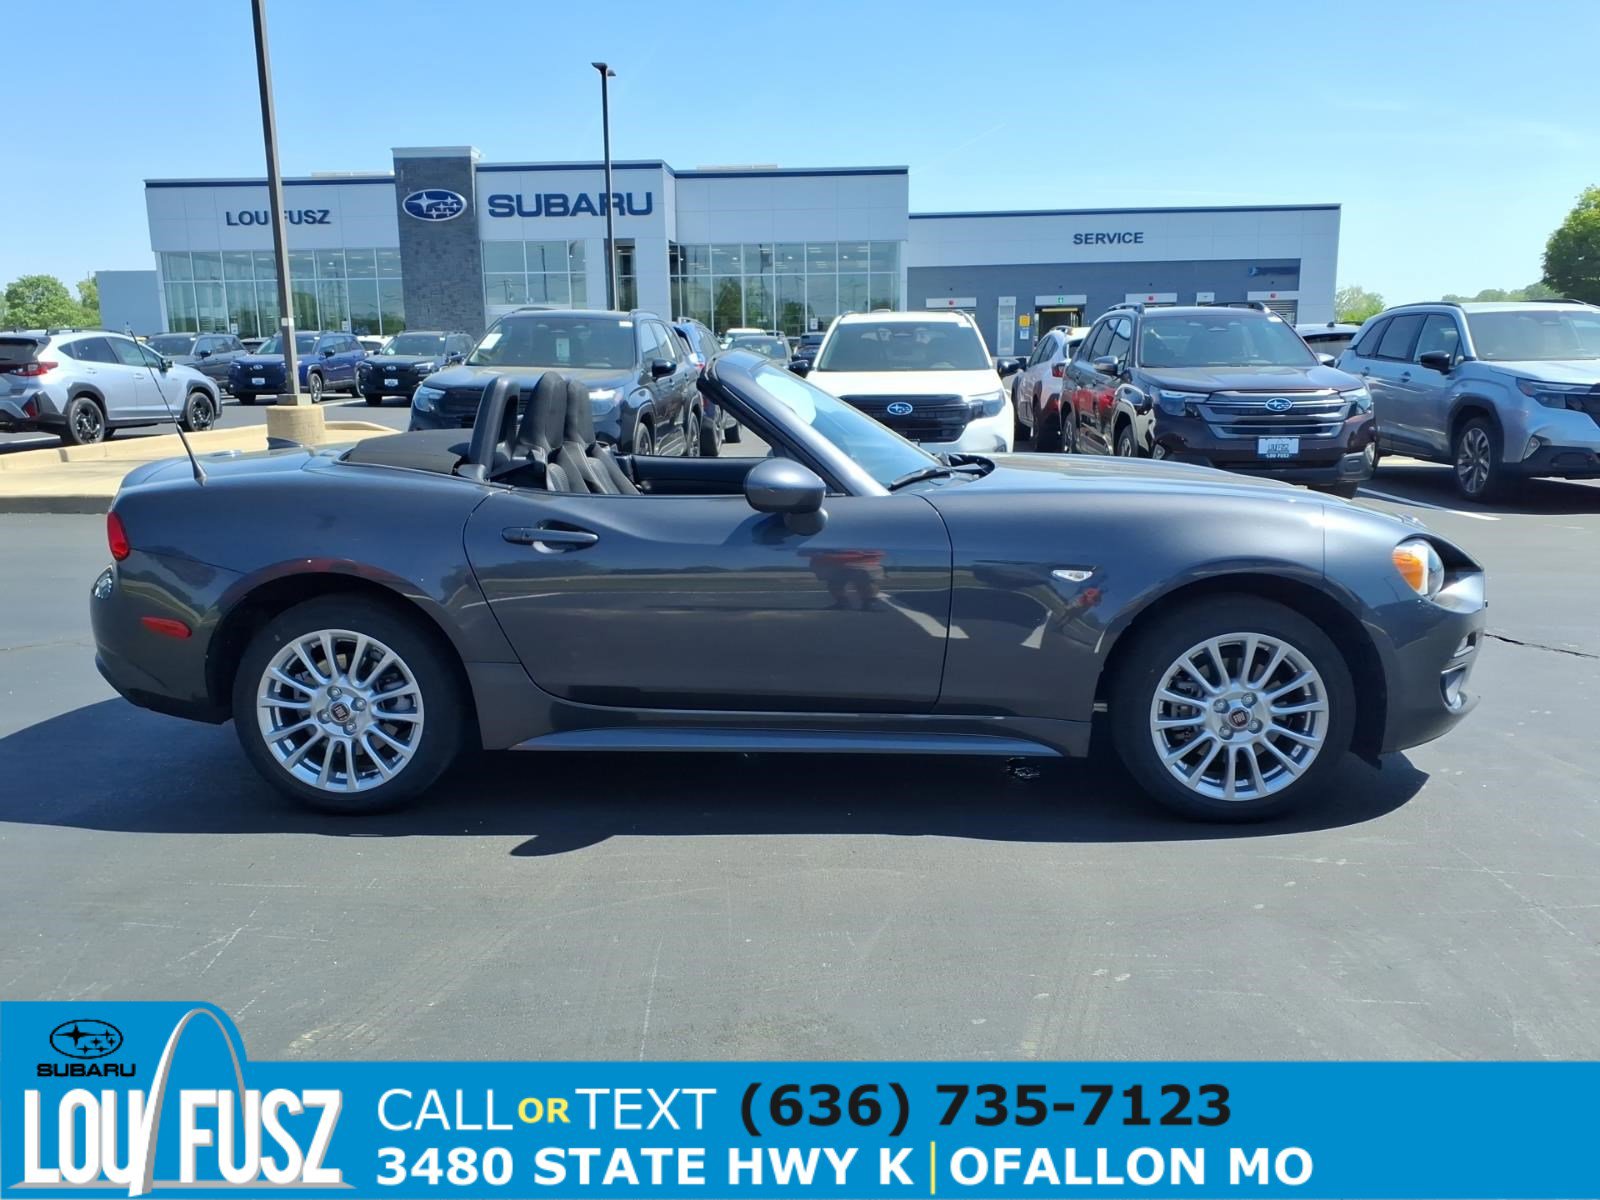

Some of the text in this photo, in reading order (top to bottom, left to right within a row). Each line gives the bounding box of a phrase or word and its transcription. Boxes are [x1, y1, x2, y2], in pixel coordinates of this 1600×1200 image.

[487, 192, 653, 217] SUBARU
[225, 210, 270, 226] LOU
[1072, 231, 1144, 245] SERVICE
